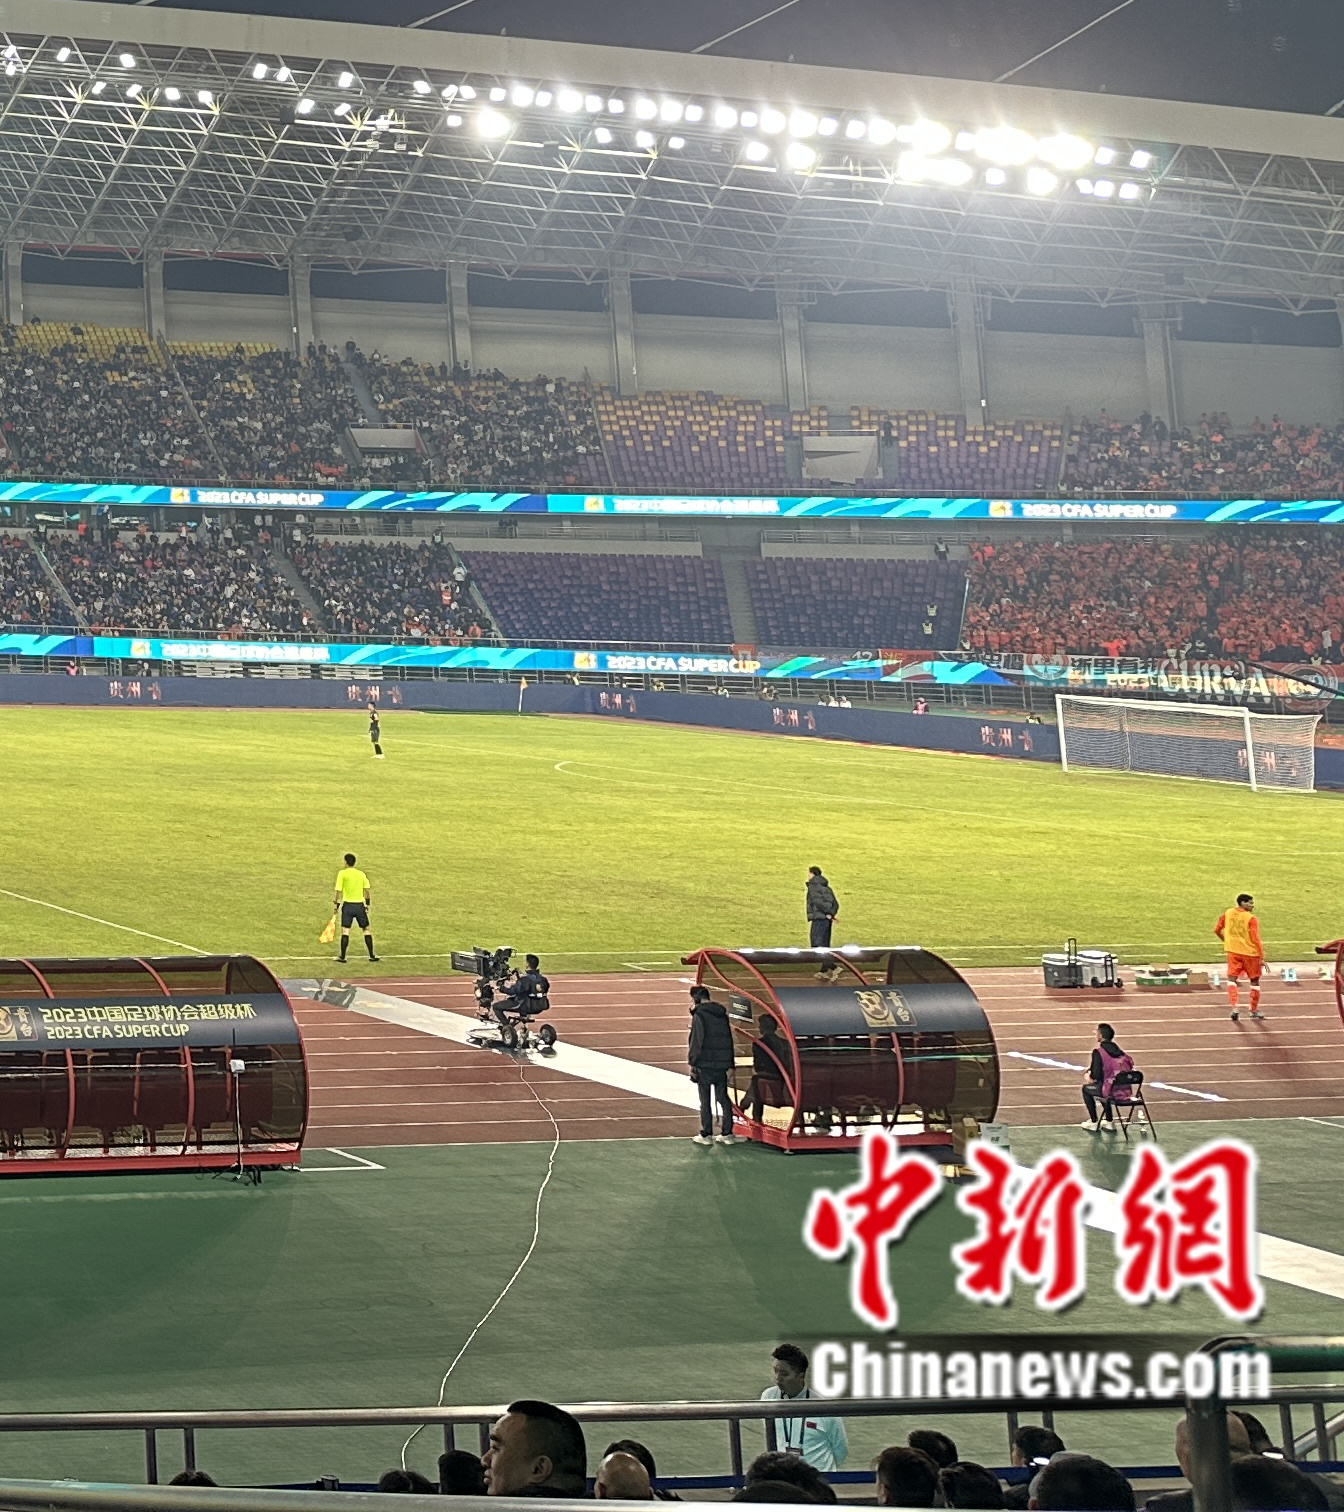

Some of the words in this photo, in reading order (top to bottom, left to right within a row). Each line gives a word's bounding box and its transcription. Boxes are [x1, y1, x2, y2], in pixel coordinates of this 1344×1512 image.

[231, 490, 255, 504] CFA
[256, 491, 298, 505] SUPER
[299, 492, 324, 505] CUP
[1062, 502, 1093, 517] CFA
[1094, 503, 1143, 518] SUPER
[1144, 504, 1177, 518] CUP
[646, 656, 677, 671] CFA
[678, 657, 728, 673] SUPER
[728, 658, 760, 674] CUP
[38, 1003, 258, 1023] 2023中国足球协会超级杯
[43, 1025, 82, 1040] 2023
[84, 1024, 113, 1039] CFA
[115, 1023, 162, 1038] SUPER
[162, 1022, 190, 1037] CUP
